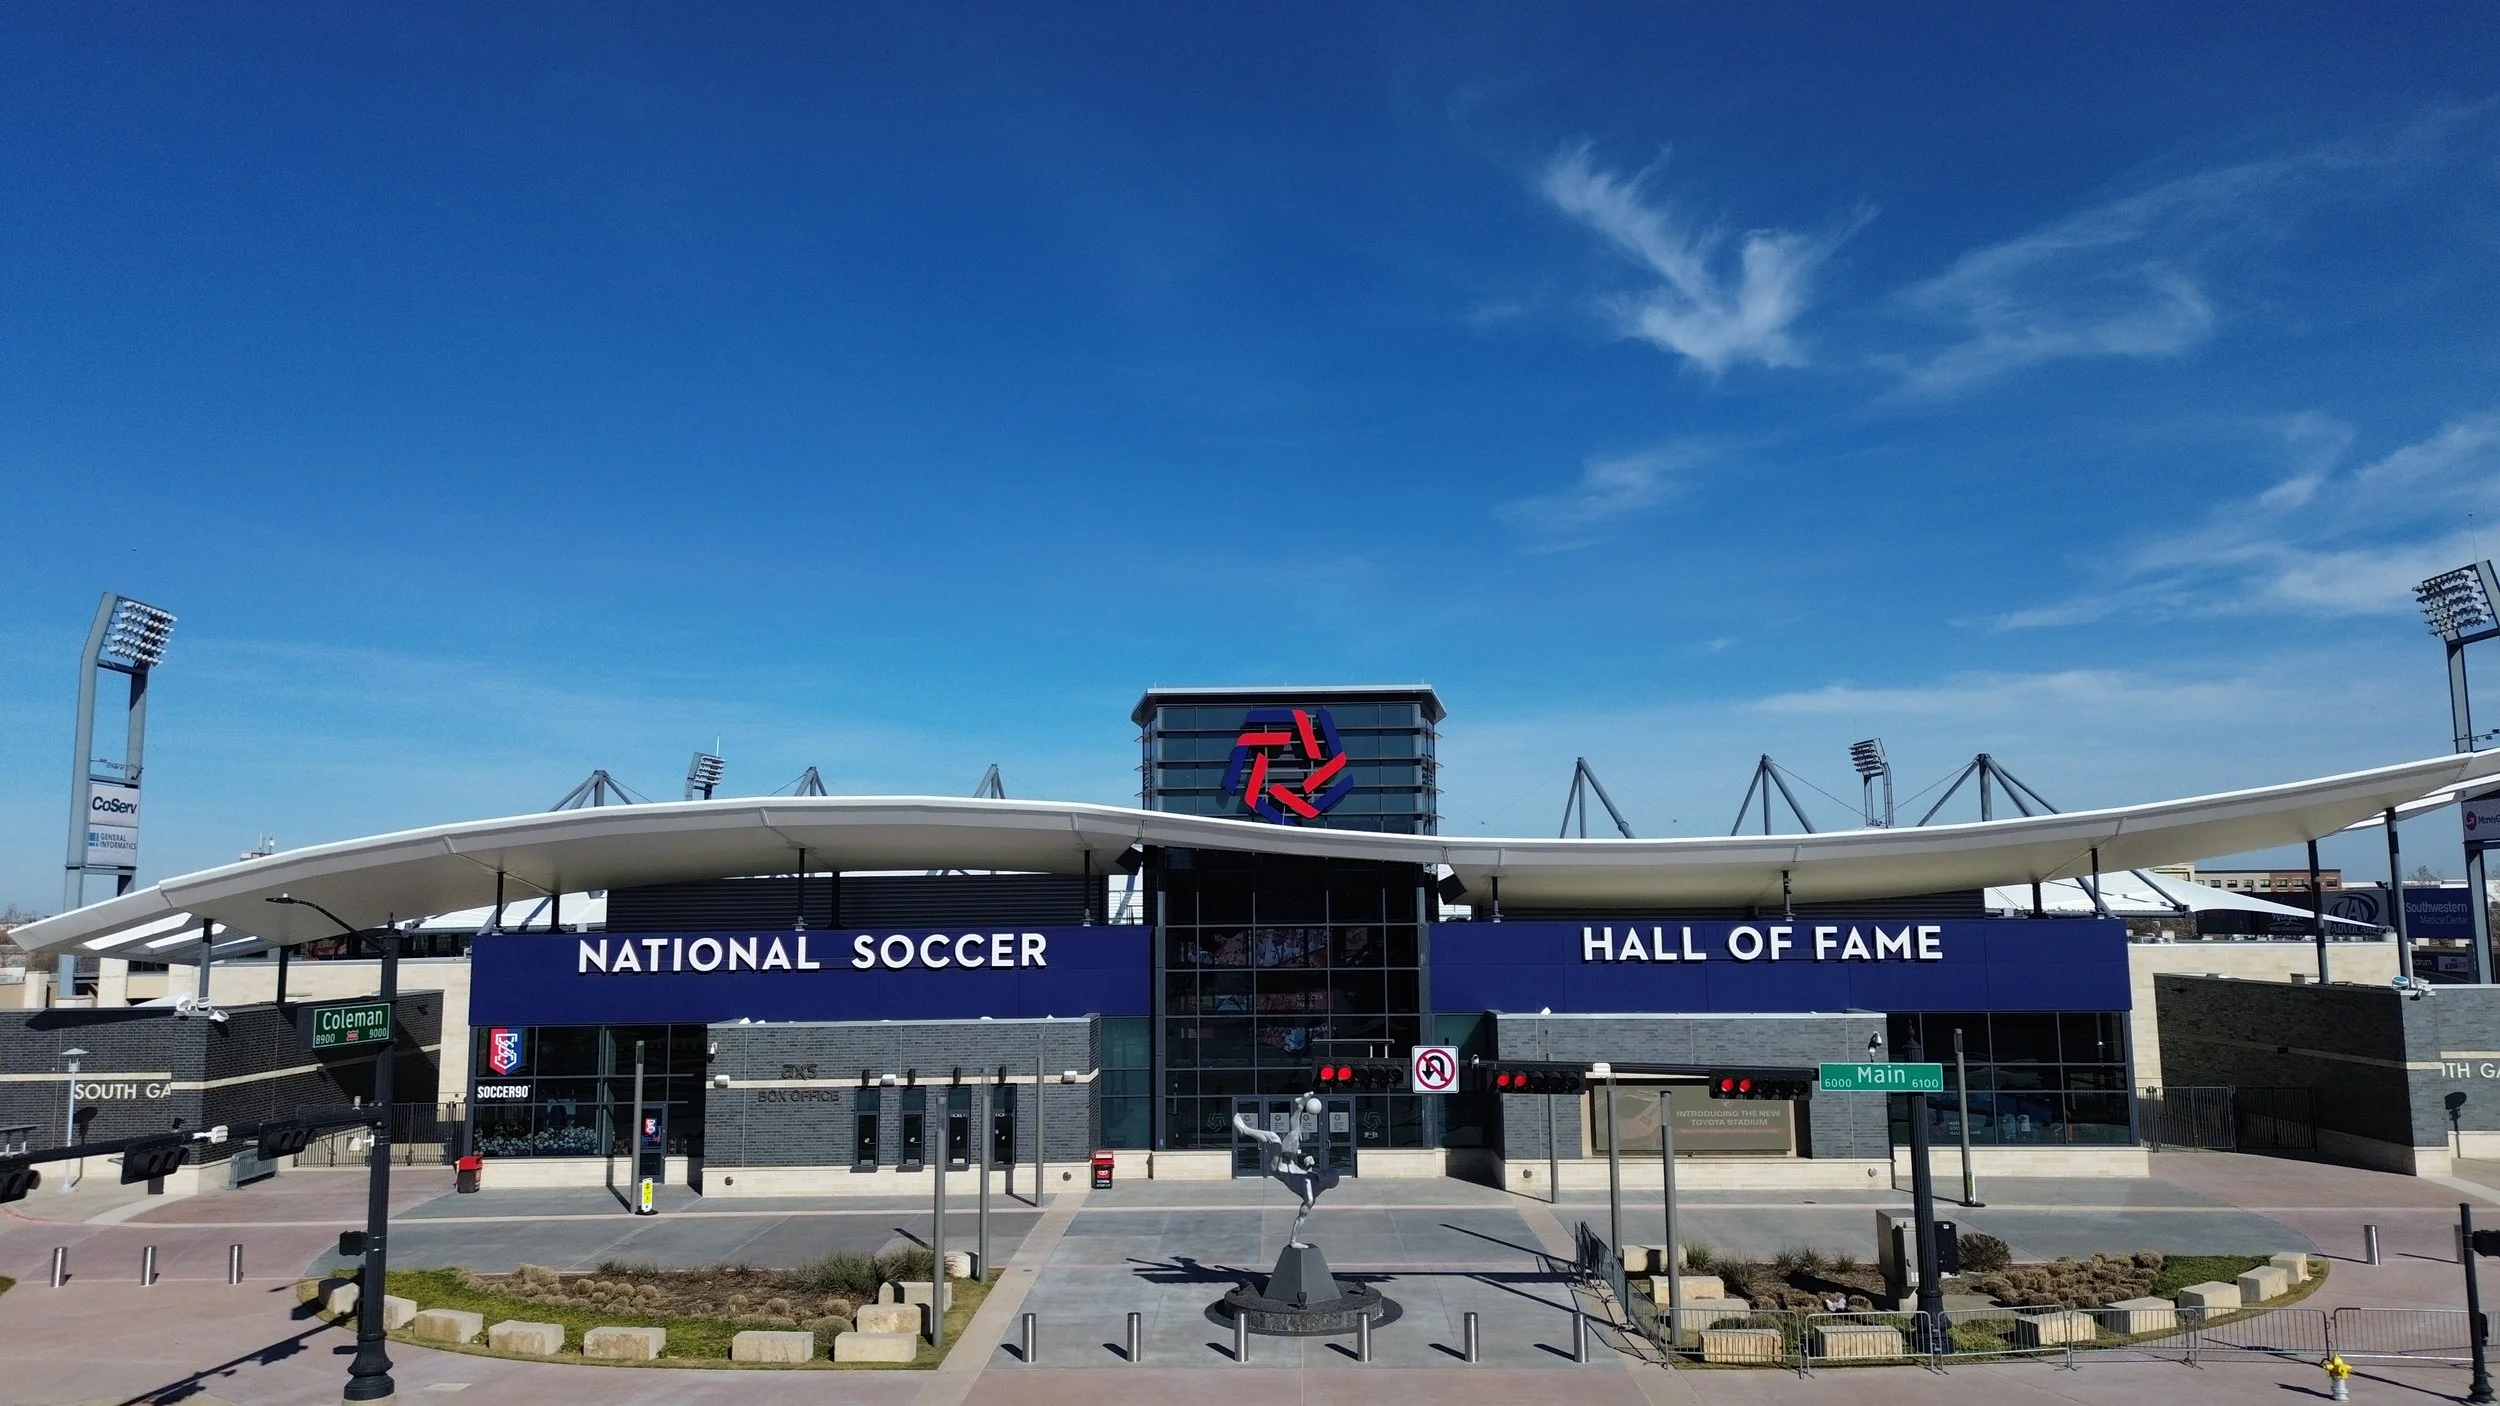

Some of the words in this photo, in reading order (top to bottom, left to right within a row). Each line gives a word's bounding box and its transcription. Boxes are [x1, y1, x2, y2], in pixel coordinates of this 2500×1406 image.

[92, 796, 138, 814] CoServ
[101, 833, 126, 842] GENERAL
[100, 841, 137, 850] INFORMATICS
[2405, 901, 2468, 913] Southwestern
[1583, 926, 1707, 961] HALL
[1728, 926, 1793, 960] OF
[1814, 925, 1944, 960] FAME
[578, 936, 821, 973] NATIONAL
[851, 933, 1047, 969] SOCCER
[323, 1009, 383, 1031] Coleman
[315, 1033, 336, 1045] 8900
[369, 1027, 387, 1039] 9000
[1857, 1065, 1906, 1084] Main
[1824, 1078, 1852, 1088] 6000
[1911, 1078, 1939, 1088] 6100
[74, 1083, 137, 1100] SOUTH
[477, 1085, 529, 1099] SOCCER90
[757, 1090, 787, 1103] BOX
[791, 1090, 840, 1103] OFFICE
[1676, 1110, 1739, 1118] INTRODUCING
[1758, 1109, 1781, 1117] NEW
[1727, 1118, 1768, 1126] STADIUM
